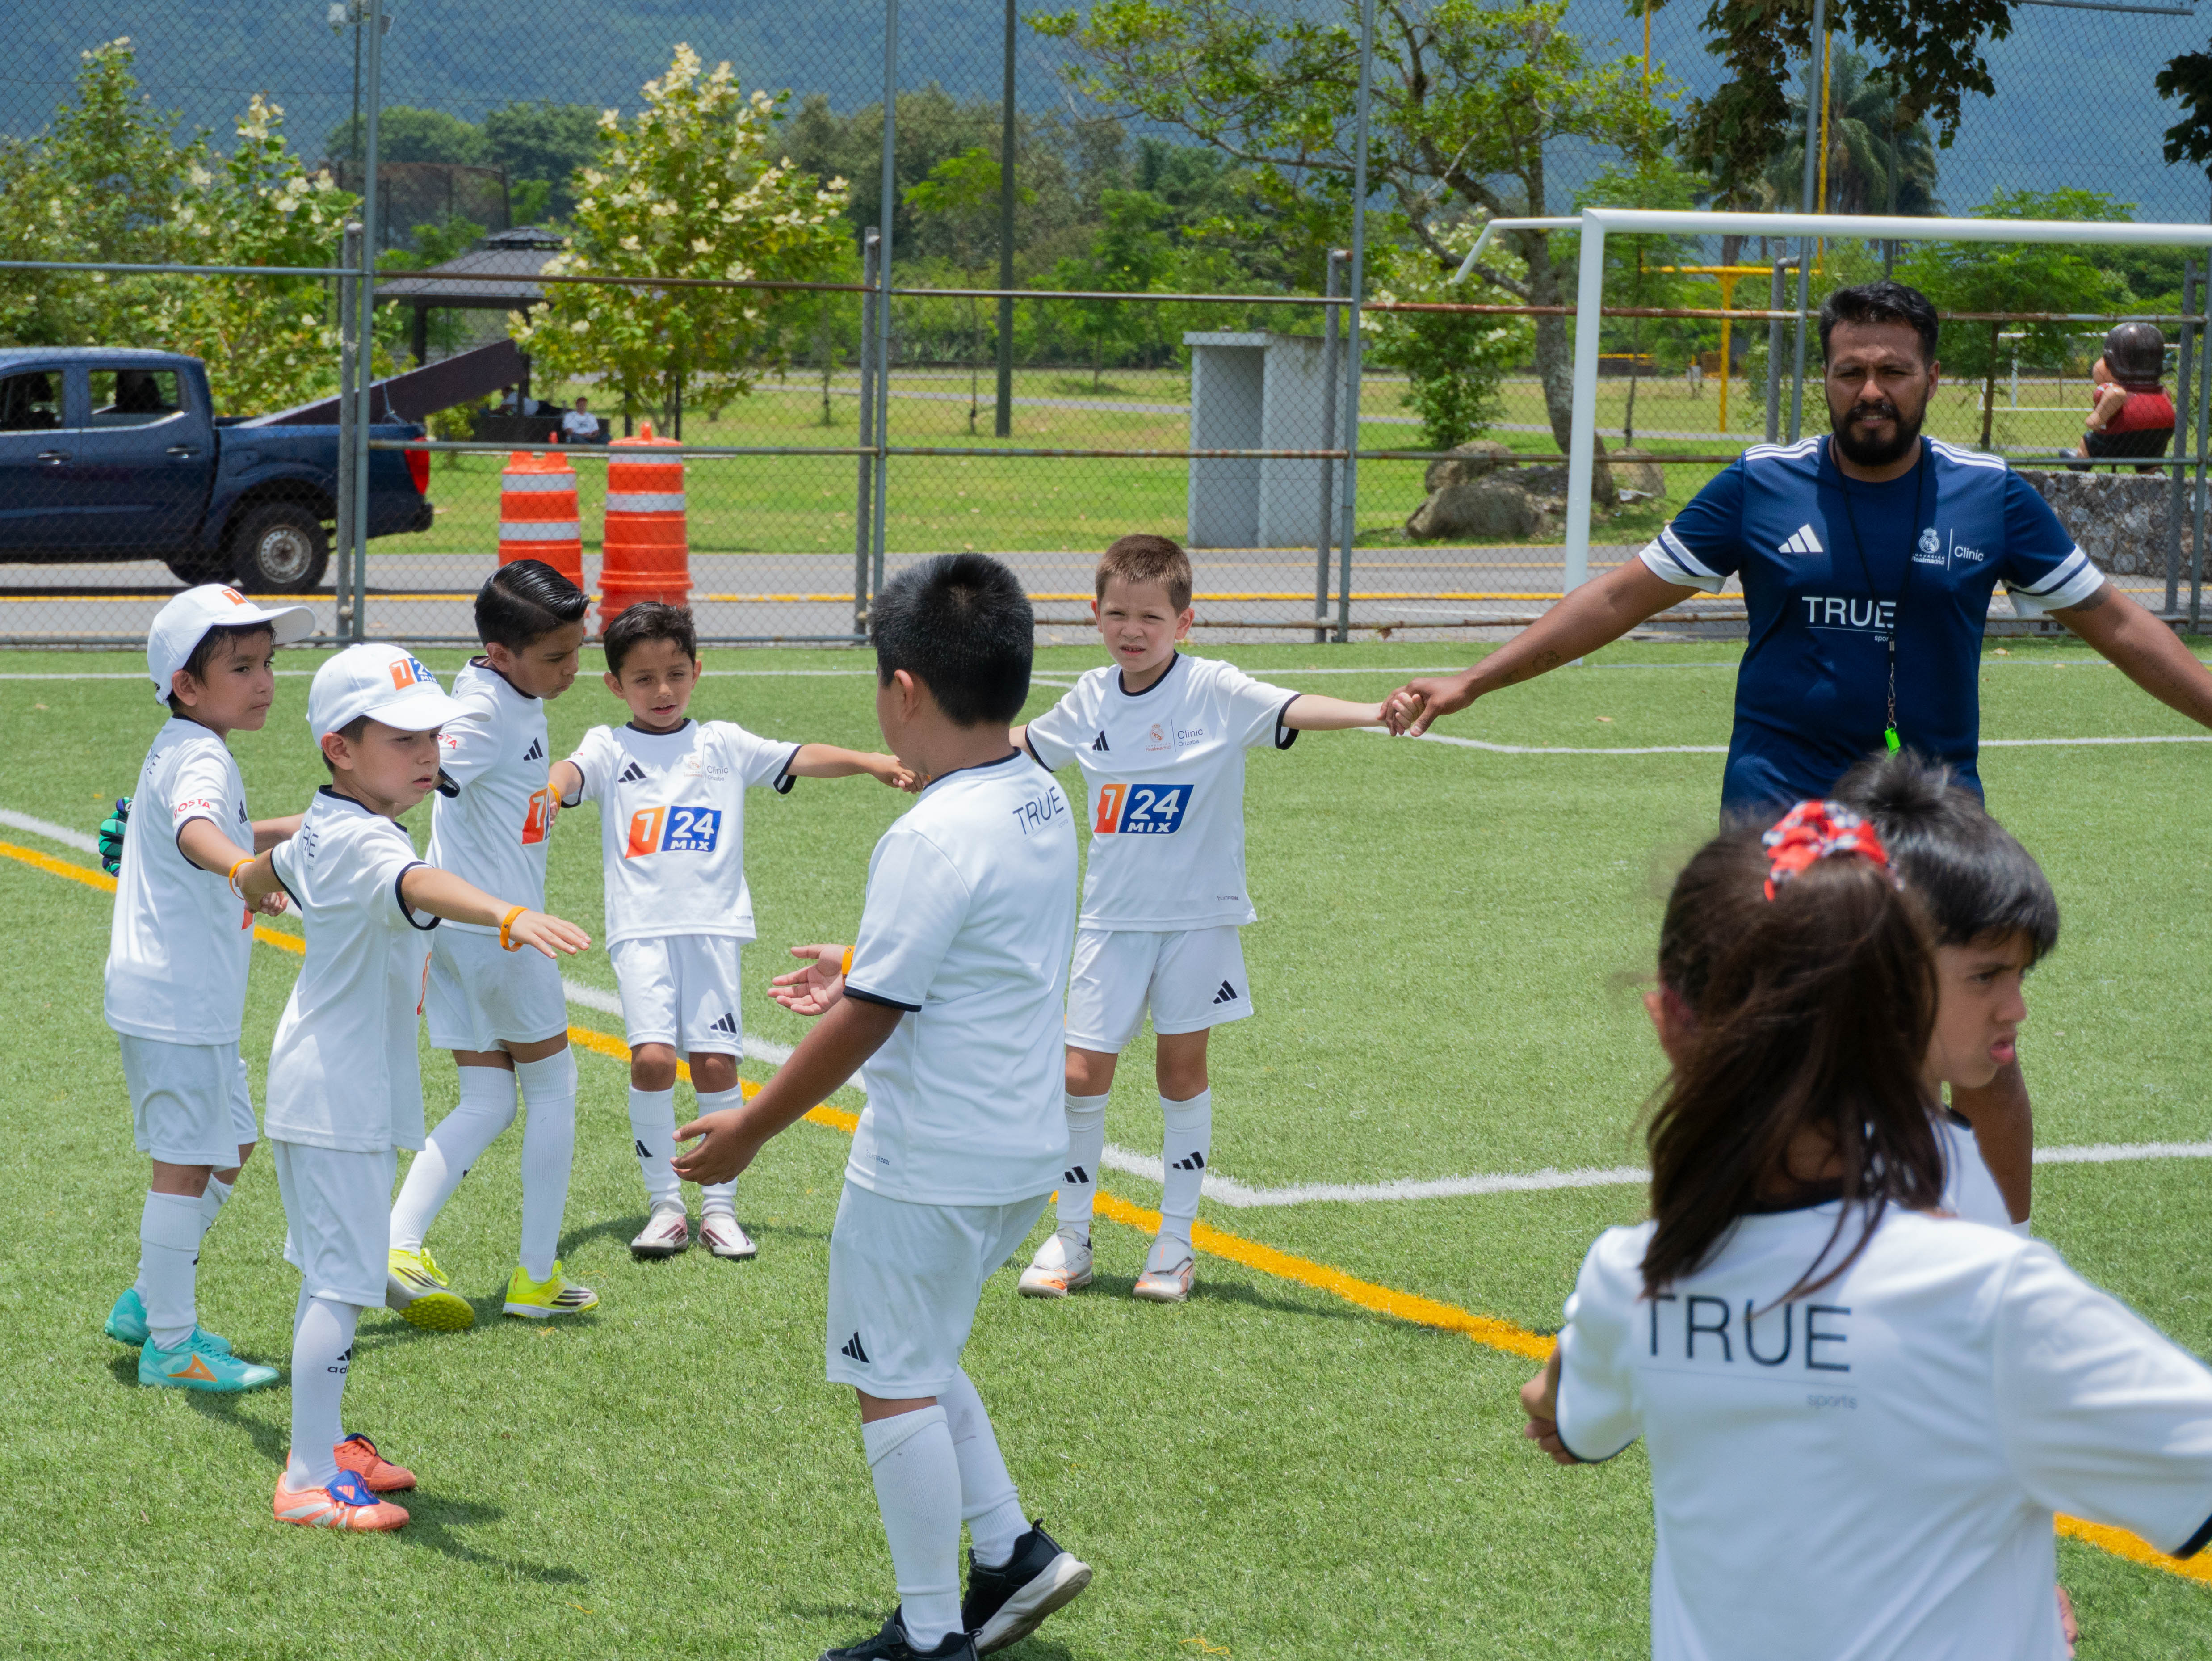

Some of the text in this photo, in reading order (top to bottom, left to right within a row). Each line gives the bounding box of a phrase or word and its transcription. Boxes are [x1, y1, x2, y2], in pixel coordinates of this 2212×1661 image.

[1911, 556, 1944, 565] Realmadrid
[1954, 546, 1984, 562] Clinic
[1802, 597, 1896, 628] TRUE
[1177, 728, 1203, 739] Clinic
[707, 765, 729, 774] Clinic
[1012, 786, 1064, 835] TRUE
[1130, 789, 1179, 820] 24
[672, 811, 714, 839] 24
[1127, 822, 1171, 833] MIX
[671, 840, 710, 851] MIX
[1649, 1294, 1851, 1372] TRUE
[1807, 1394, 1858, 1409] sports
